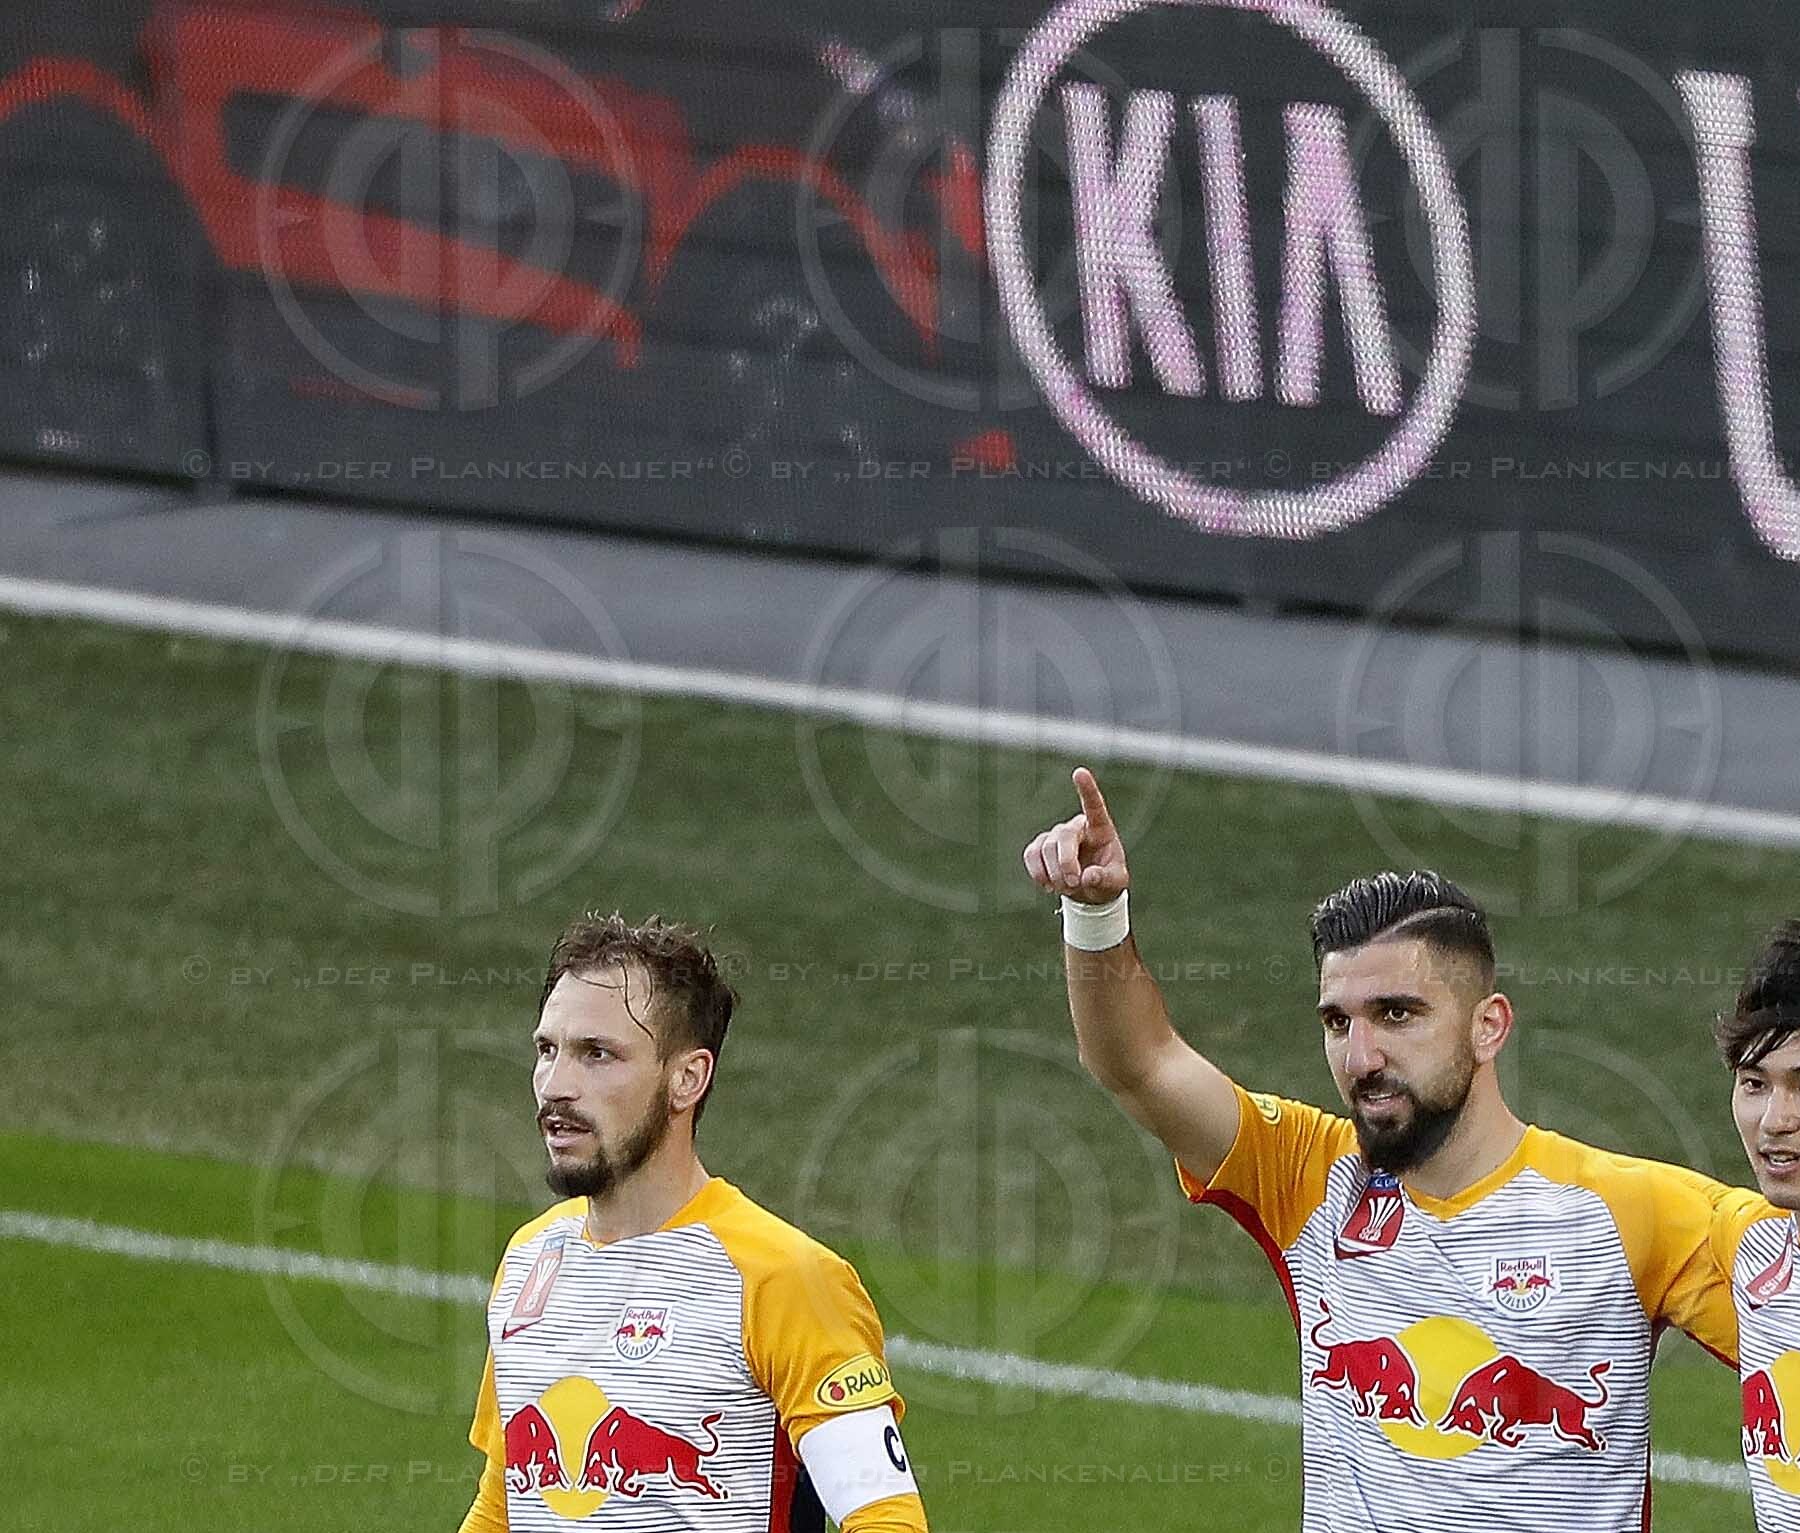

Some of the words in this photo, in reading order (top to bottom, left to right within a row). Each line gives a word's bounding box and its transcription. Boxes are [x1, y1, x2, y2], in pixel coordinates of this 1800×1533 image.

[1060, 82, 1402, 416] KIA
[844, 1366, 885, 1396] RAU
[884, 1425, 907, 1472] C
